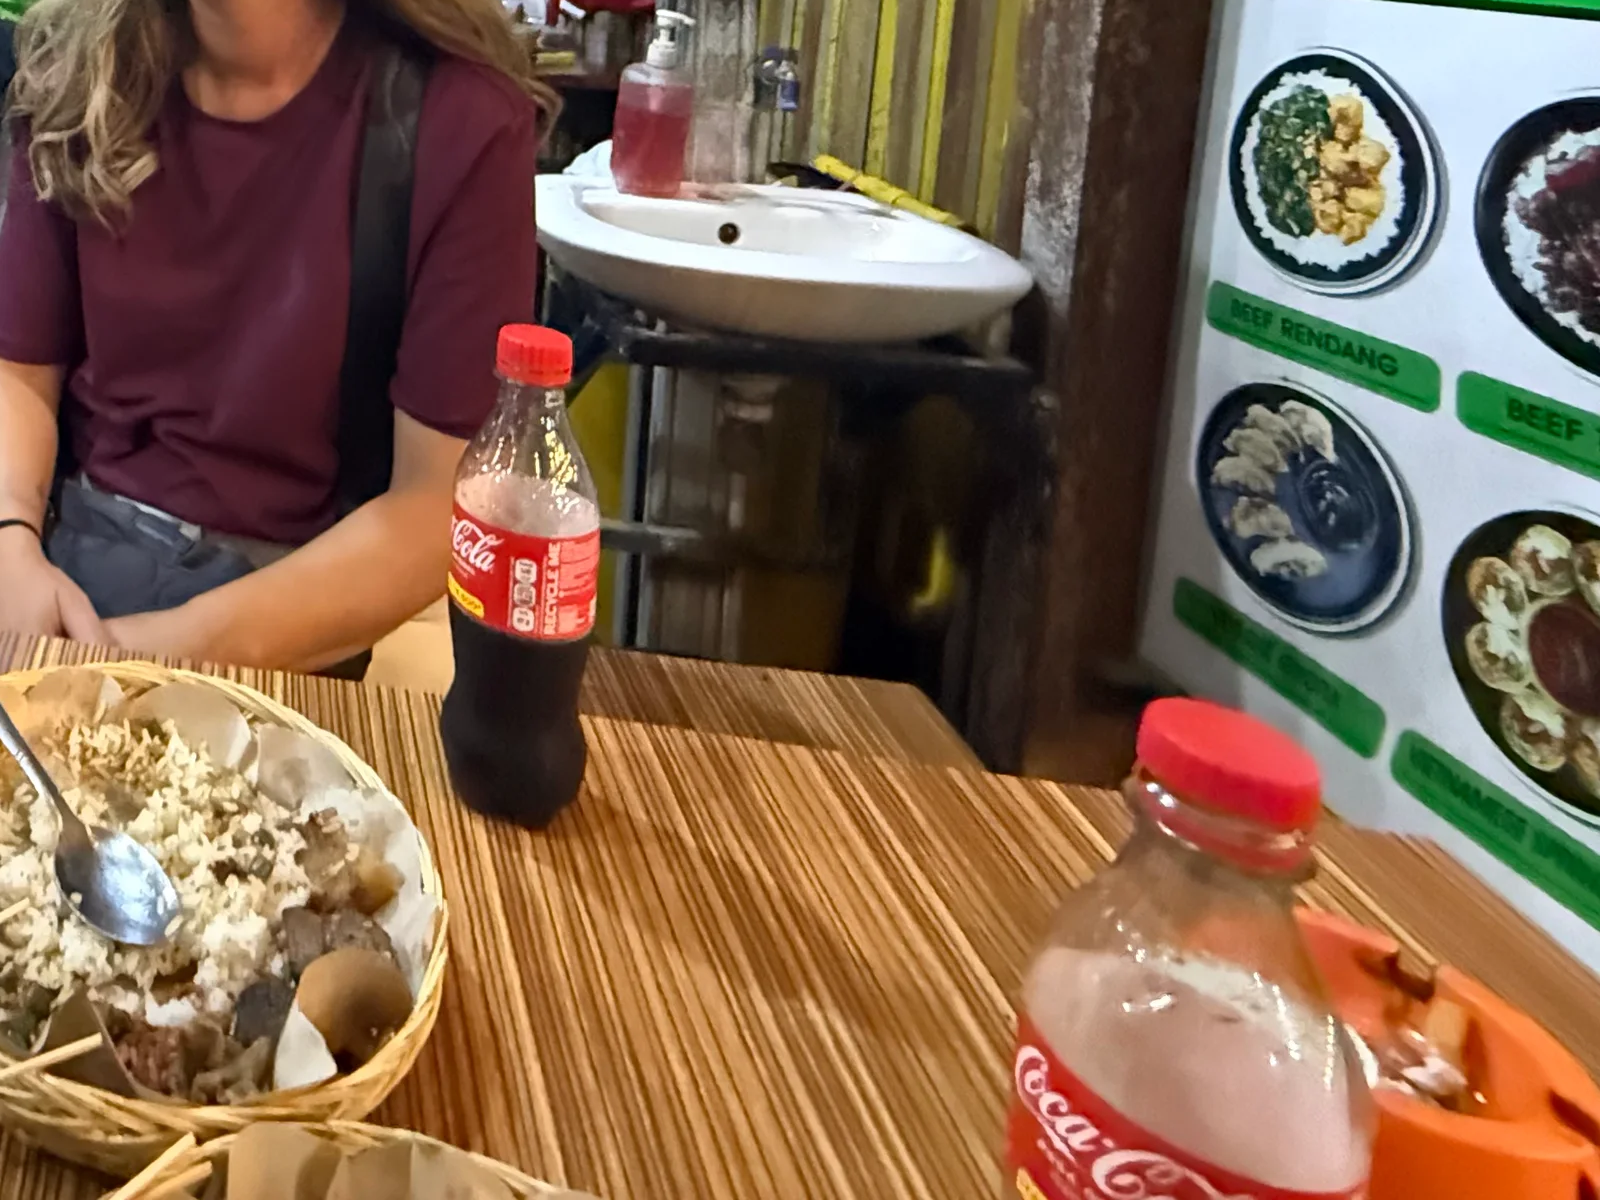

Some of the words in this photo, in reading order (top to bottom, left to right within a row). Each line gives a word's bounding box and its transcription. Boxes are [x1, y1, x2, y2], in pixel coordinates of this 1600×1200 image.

[1230, 297, 1275, 333] BEEF
[1280, 315, 1400, 378] RENDANG
[1507, 395, 1584, 441] BEEF
[547, 542, 561, 567] ME
[543, 568, 559, 635] RECYCLE
[1015, 1045, 1253, 1200] Coca-C
